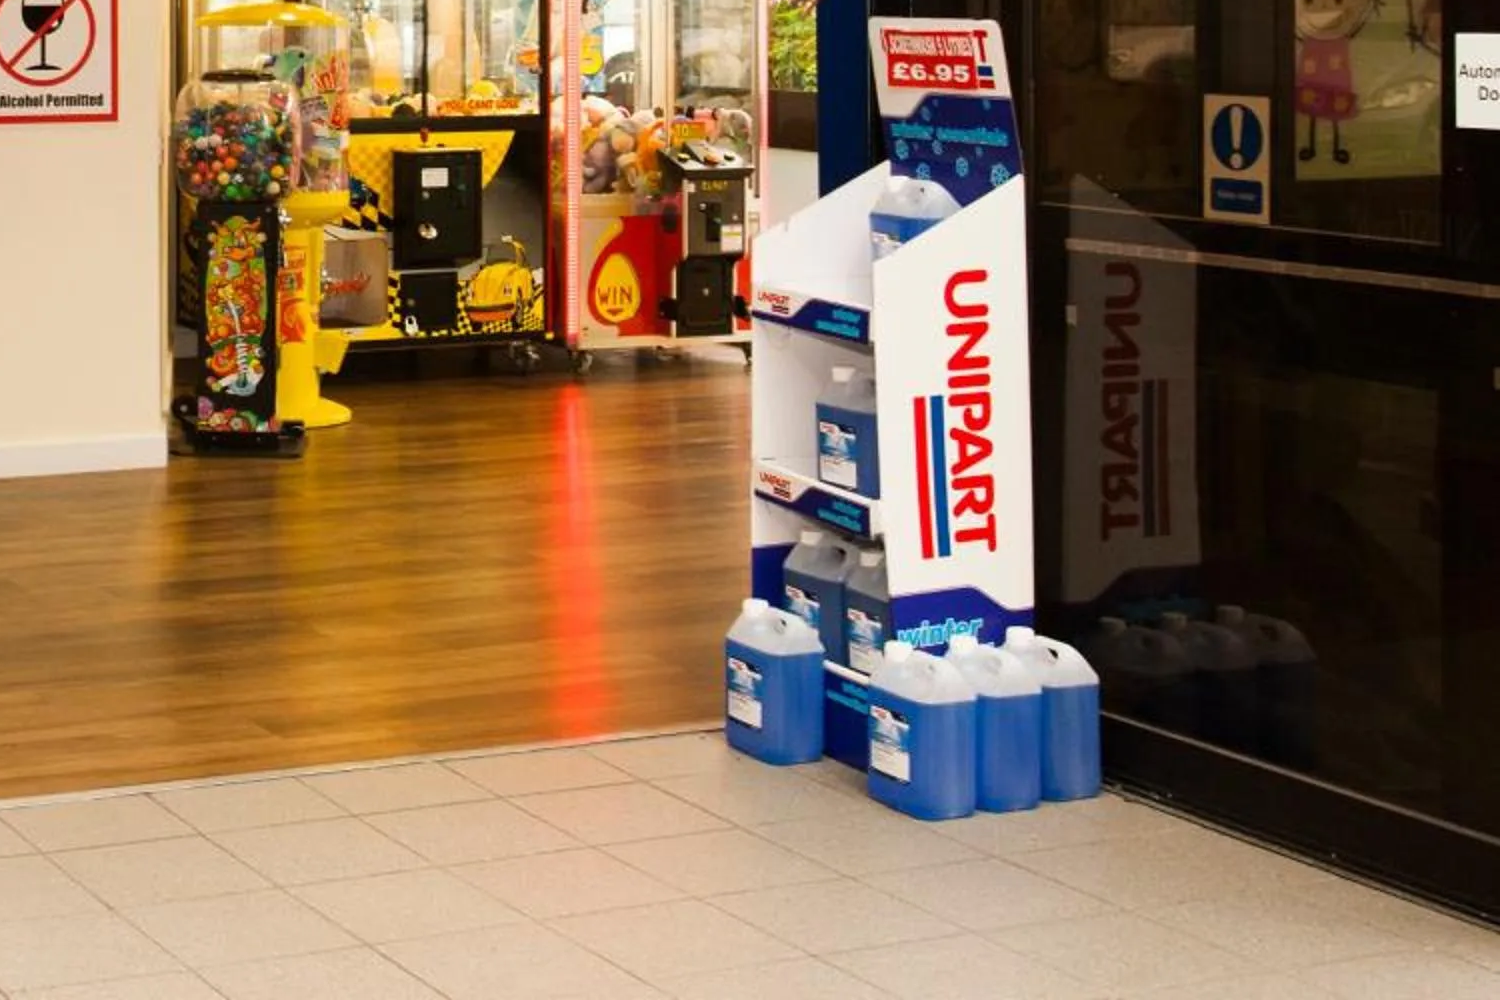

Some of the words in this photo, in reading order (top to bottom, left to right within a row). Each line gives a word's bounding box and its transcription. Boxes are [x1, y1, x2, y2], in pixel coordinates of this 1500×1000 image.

[893, 62, 971, 83] £6.95
[0, 94, 44, 109] Alcohol
[46, 93, 104, 108] Permitted
[597, 285, 633, 305] WIN
[944, 269, 996, 552] UNIPART
[897, 617, 984, 648] winter
